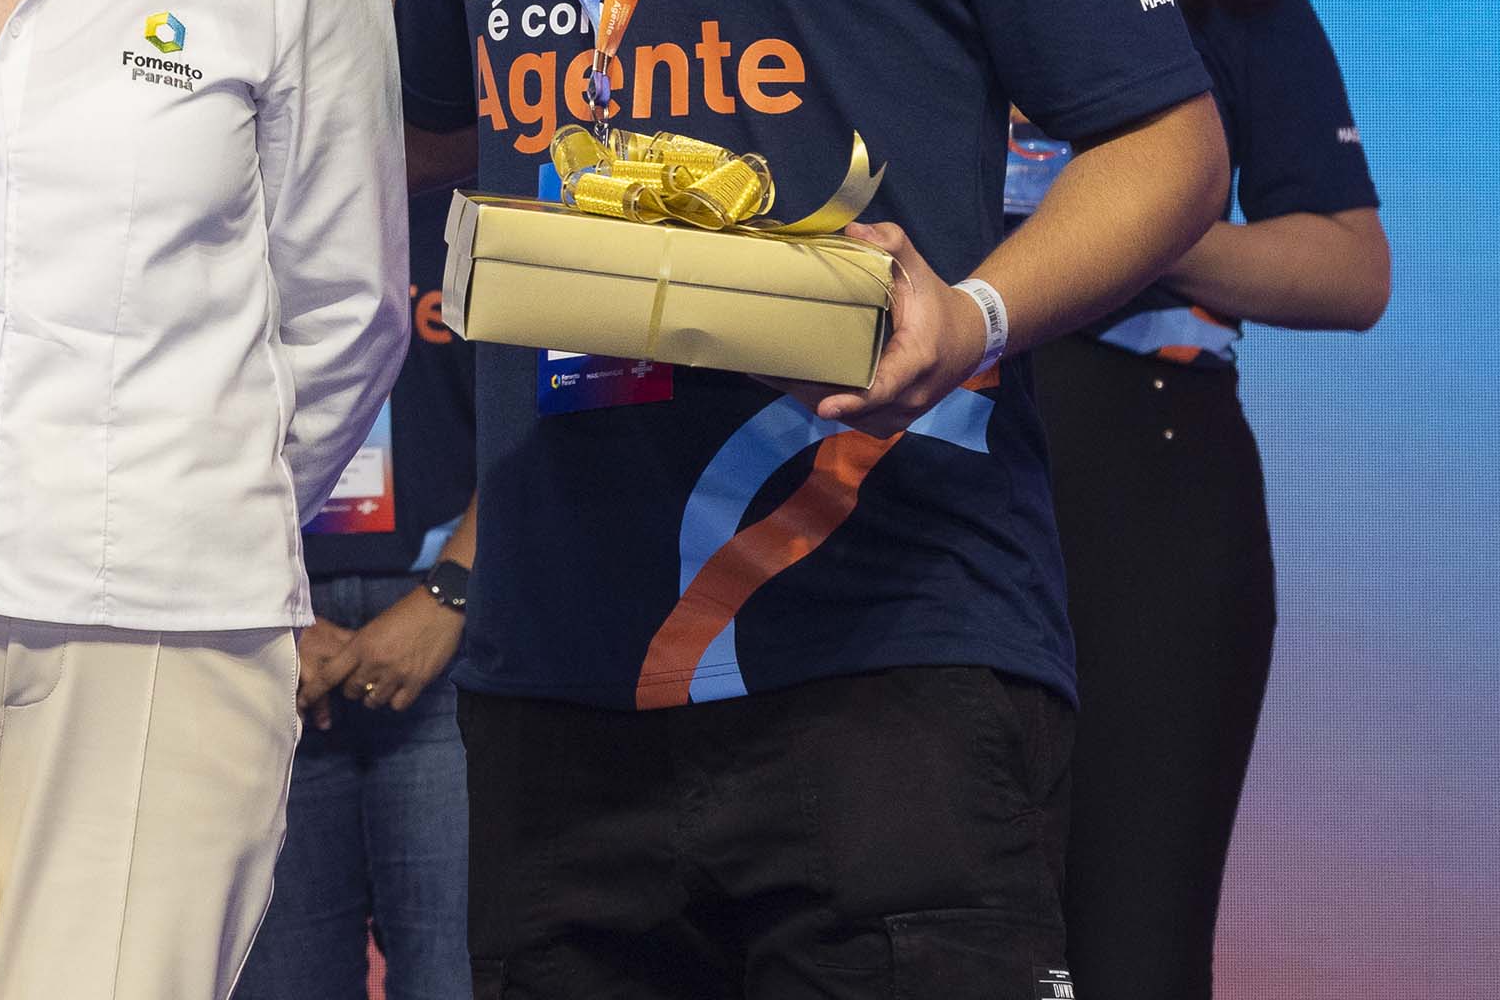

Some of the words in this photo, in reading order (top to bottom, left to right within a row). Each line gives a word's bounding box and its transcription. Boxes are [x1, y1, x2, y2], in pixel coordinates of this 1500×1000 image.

[606, 0, 622, 36] Agente
[122, 51, 204, 81] Fomento
[131, 67, 195, 93] Paraná
[476, 20, 806, 155] Agente
